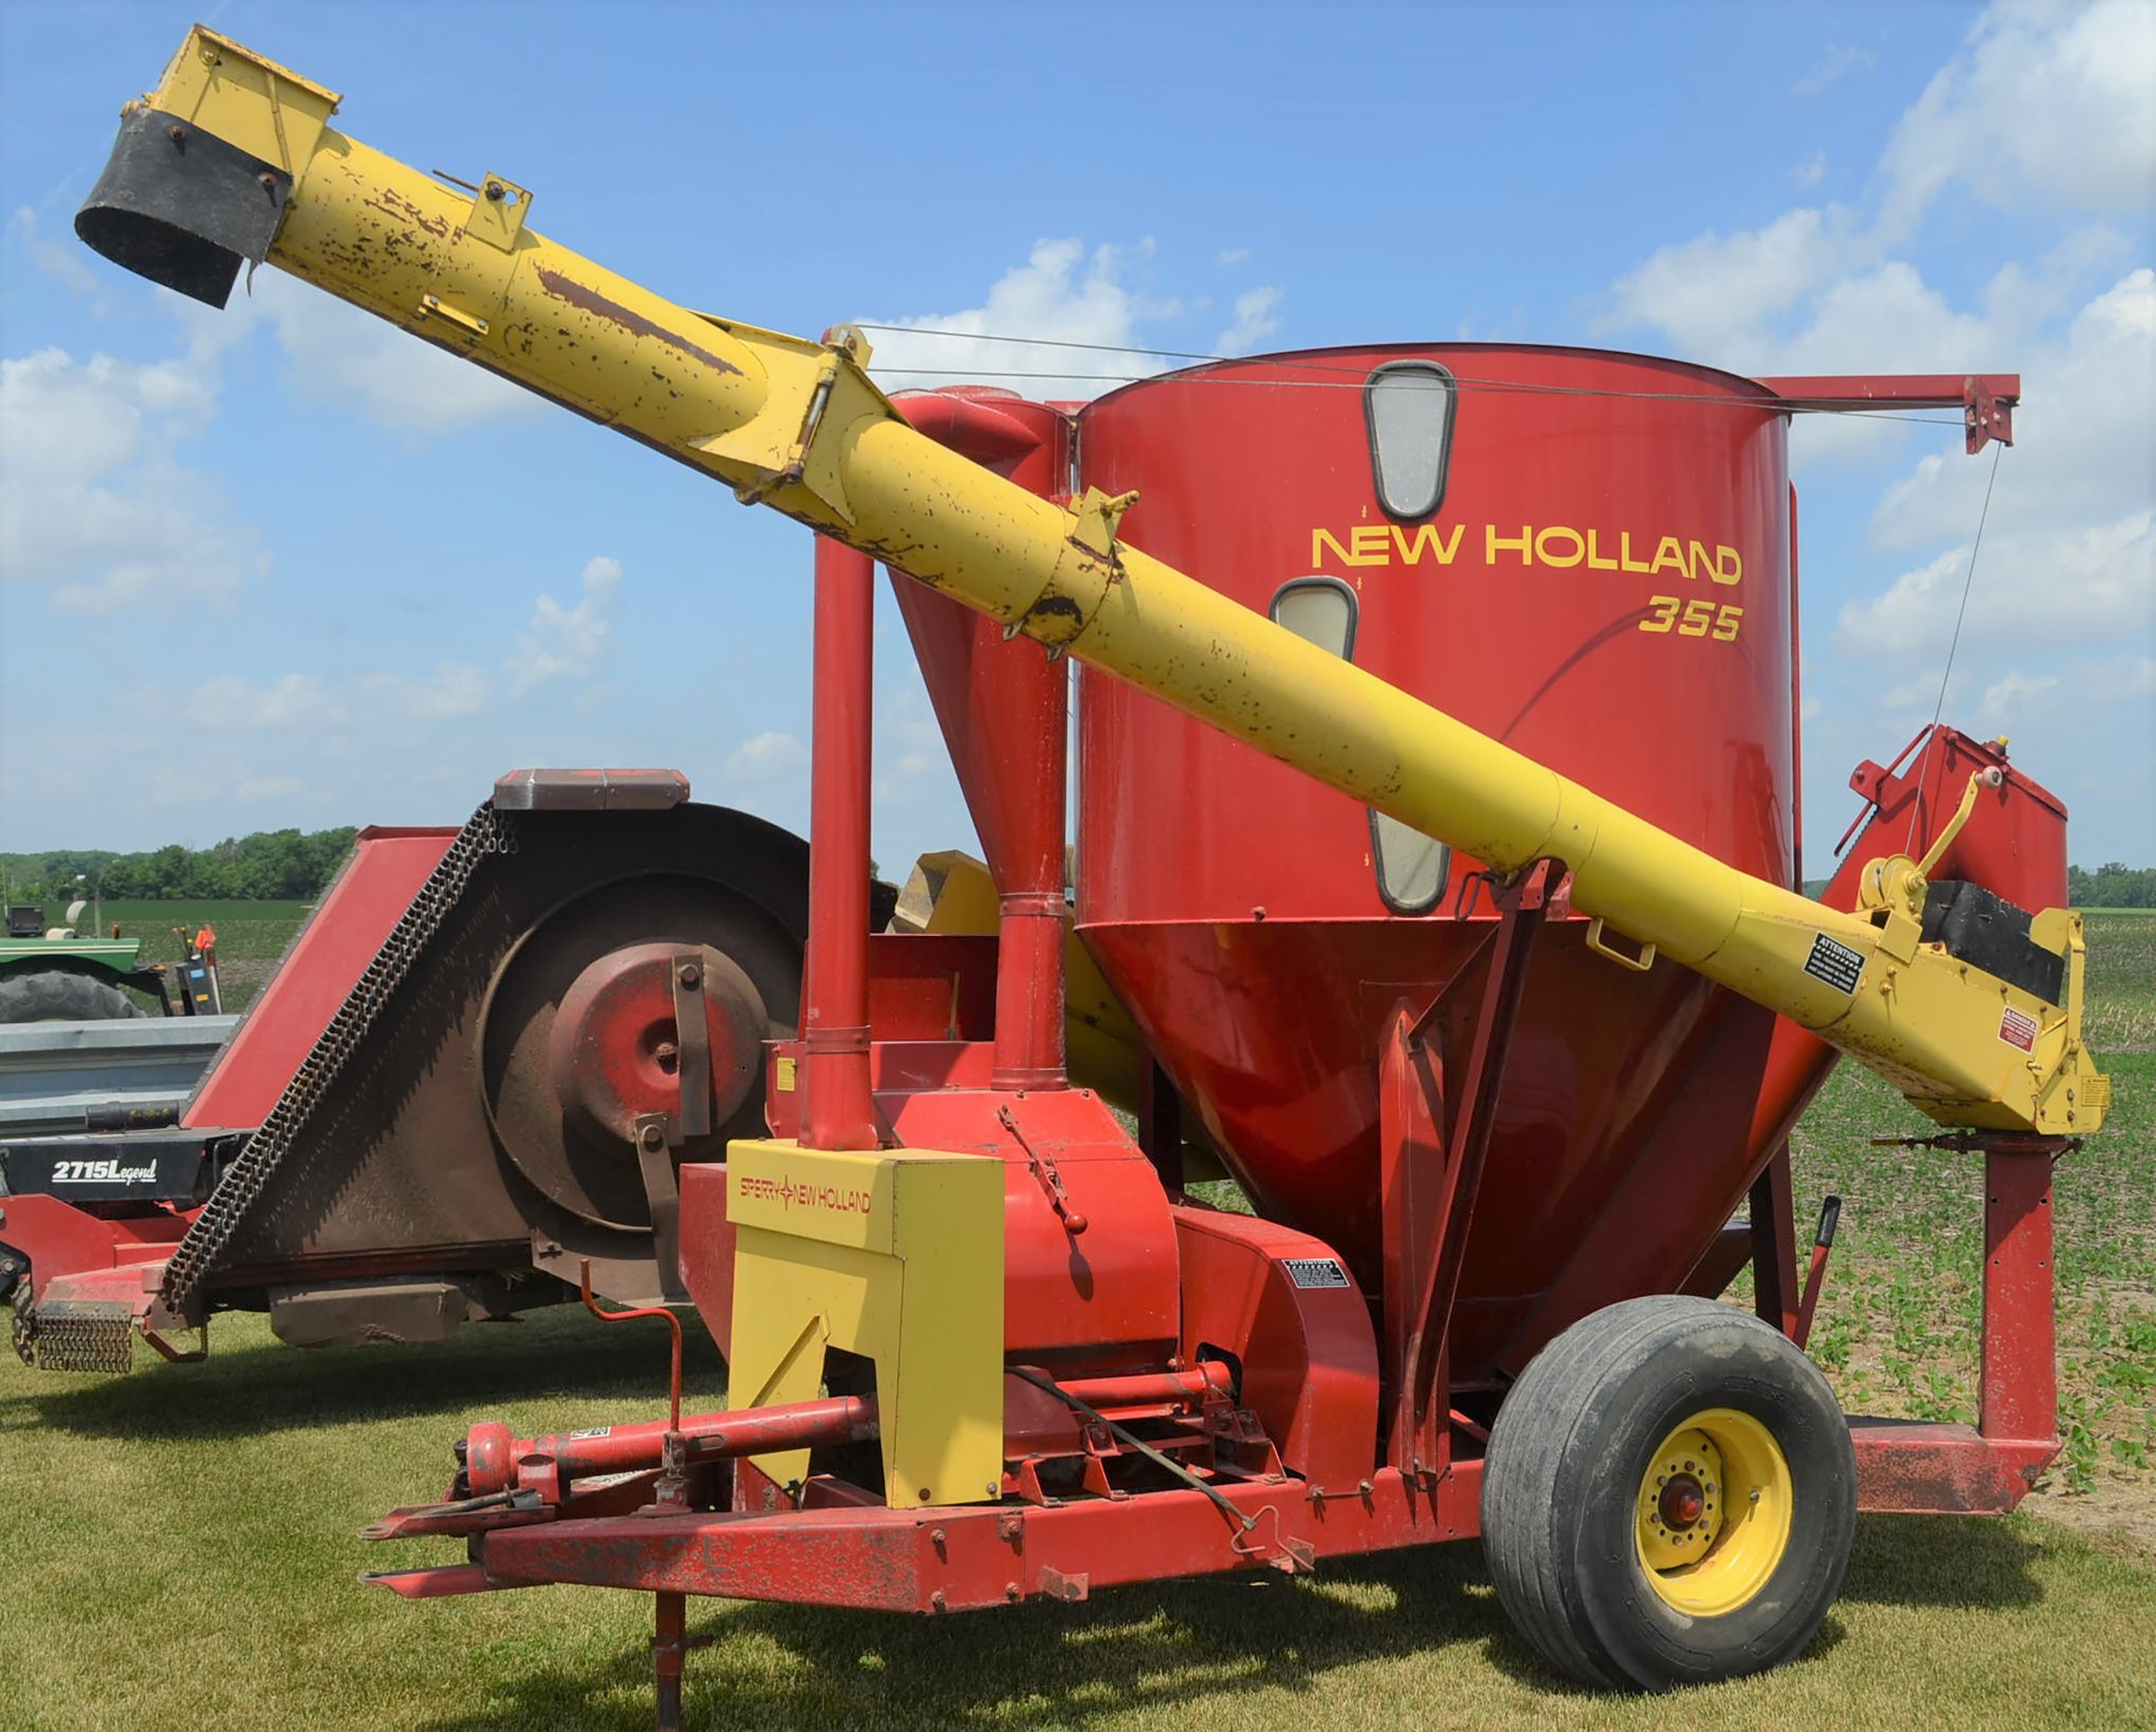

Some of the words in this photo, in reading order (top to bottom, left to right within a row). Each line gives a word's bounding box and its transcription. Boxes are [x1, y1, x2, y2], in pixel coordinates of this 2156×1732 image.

[1312, 525, 1465, 569] NEW
[1485, 525, 1742, 586] HOLLAND
[1639, 595, 1744, 641] 355
[1819, 936, 1860, 964] ATTENTION
[740, 1178, 781, 1200] SPERRY
[792, 1184, 816, 1206] NEW
[818, 1187, 870, 1214] HOLLAND
